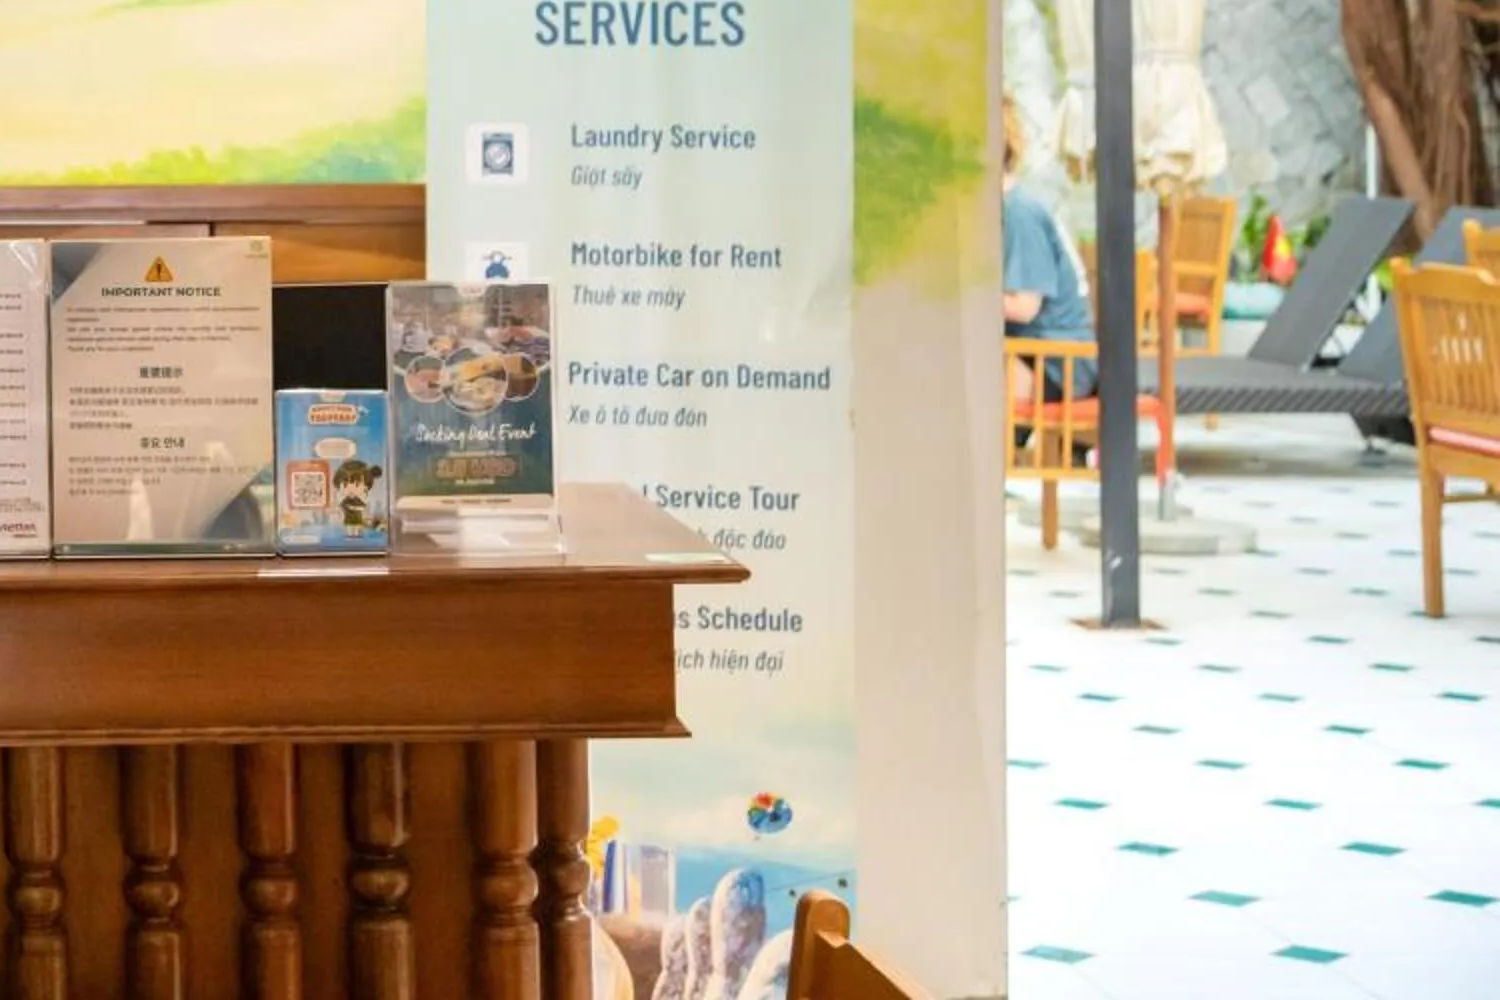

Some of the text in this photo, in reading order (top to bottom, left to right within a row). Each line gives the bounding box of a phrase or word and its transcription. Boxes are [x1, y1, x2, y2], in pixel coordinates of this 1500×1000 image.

[535, 0, 746, 47] SERVICES
[571, 123, 756, 153] Laundry Service
[571, 242, 782, 269] Motorbike for Rent
[101, 287, 221, 297] IMPORTANT NOTICE
[621, 289, 642, 306] xe
[568, 361, 831, 390] Private Car on Demand
[568, 404, 590, 425] Xe
[499, 420, 537, 440] Event
[656, 484, 741, 509] Service
[749, 485, 801, 510] Tour
[698, 604, 803, 632] Schedule
